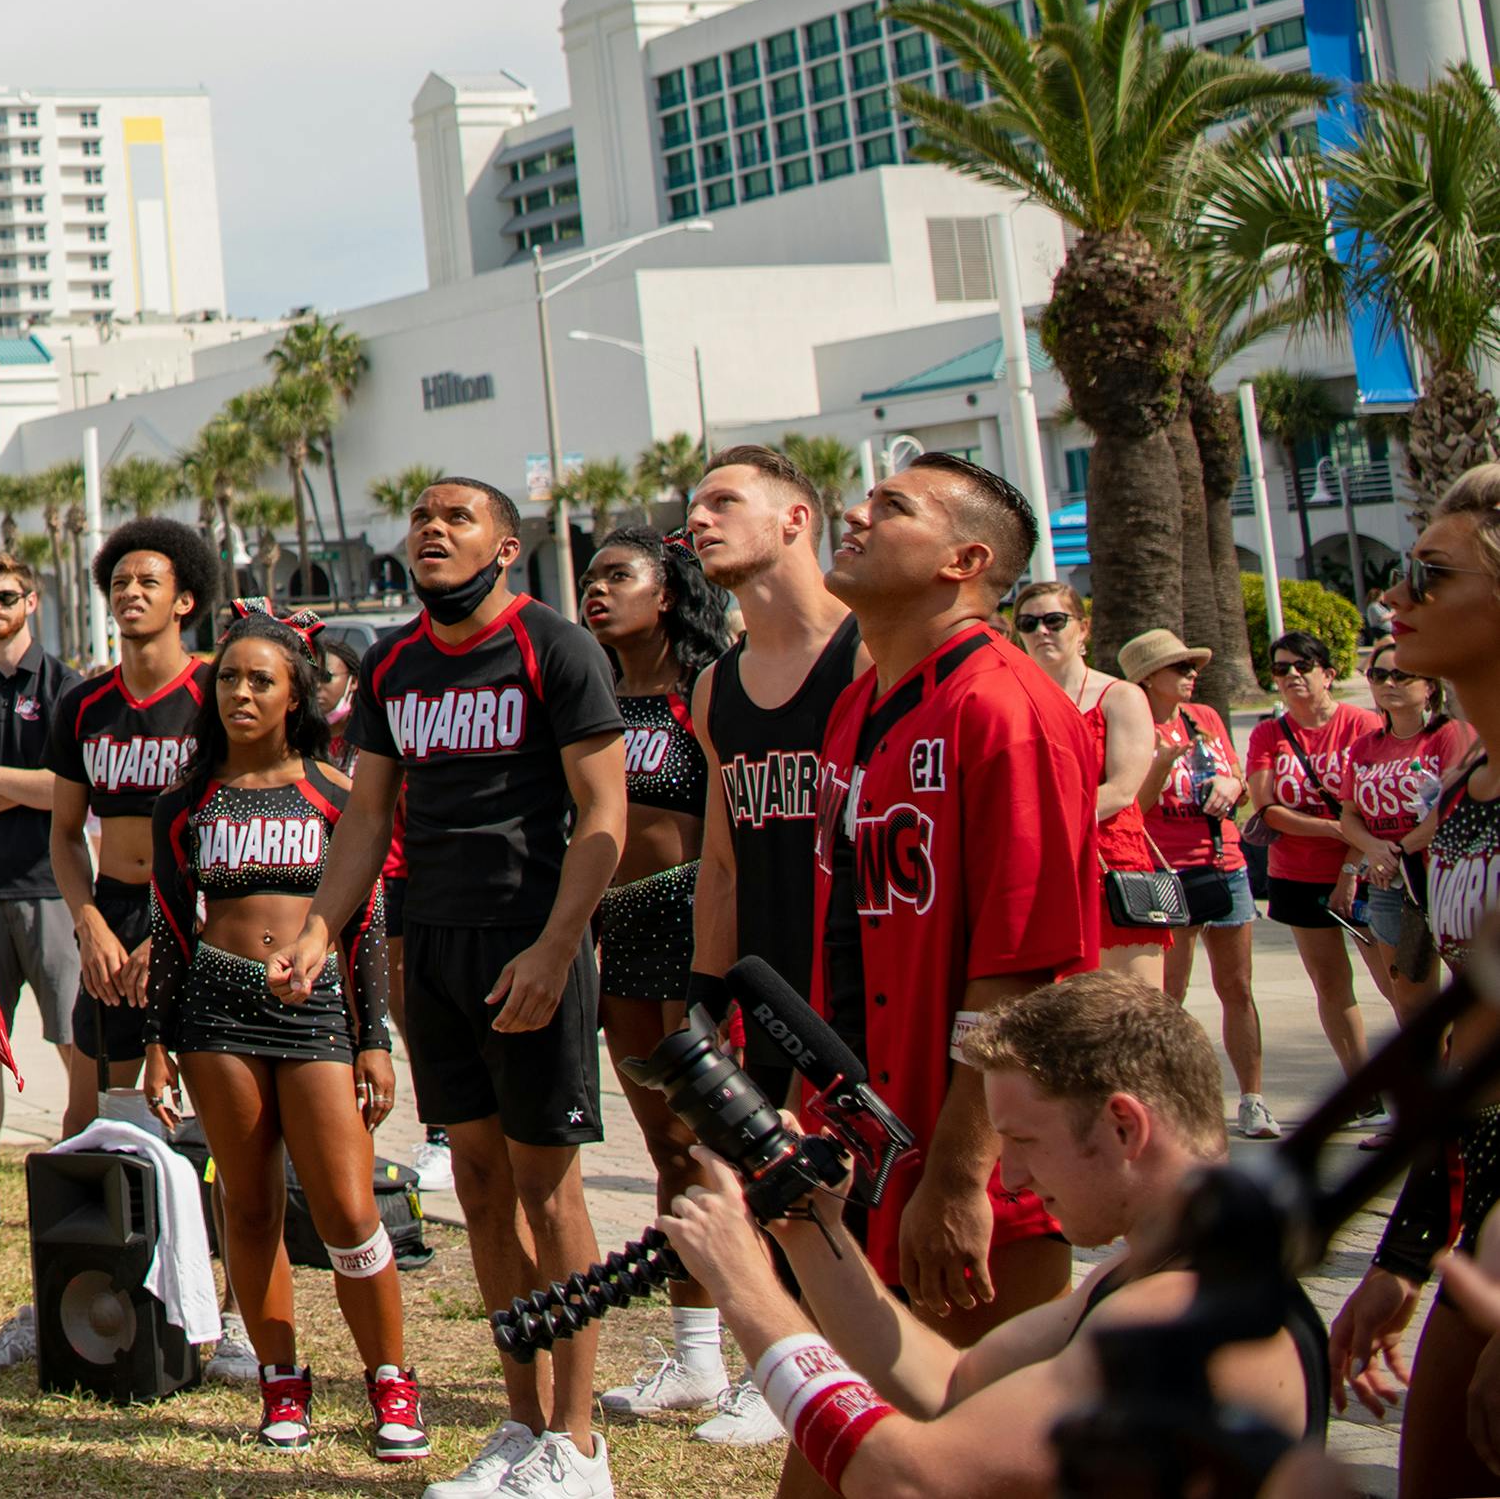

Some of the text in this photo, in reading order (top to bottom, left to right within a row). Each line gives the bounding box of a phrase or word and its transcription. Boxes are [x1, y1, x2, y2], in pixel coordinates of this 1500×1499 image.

[421, 370, 495, 411] Hilton
[383, 684, 527, 762] NAVARRO
[910, 738, 945, 793] 21
[199, 816, 327, 871] NAVARRO
[752, 1003, 817, 1069] RØDE
